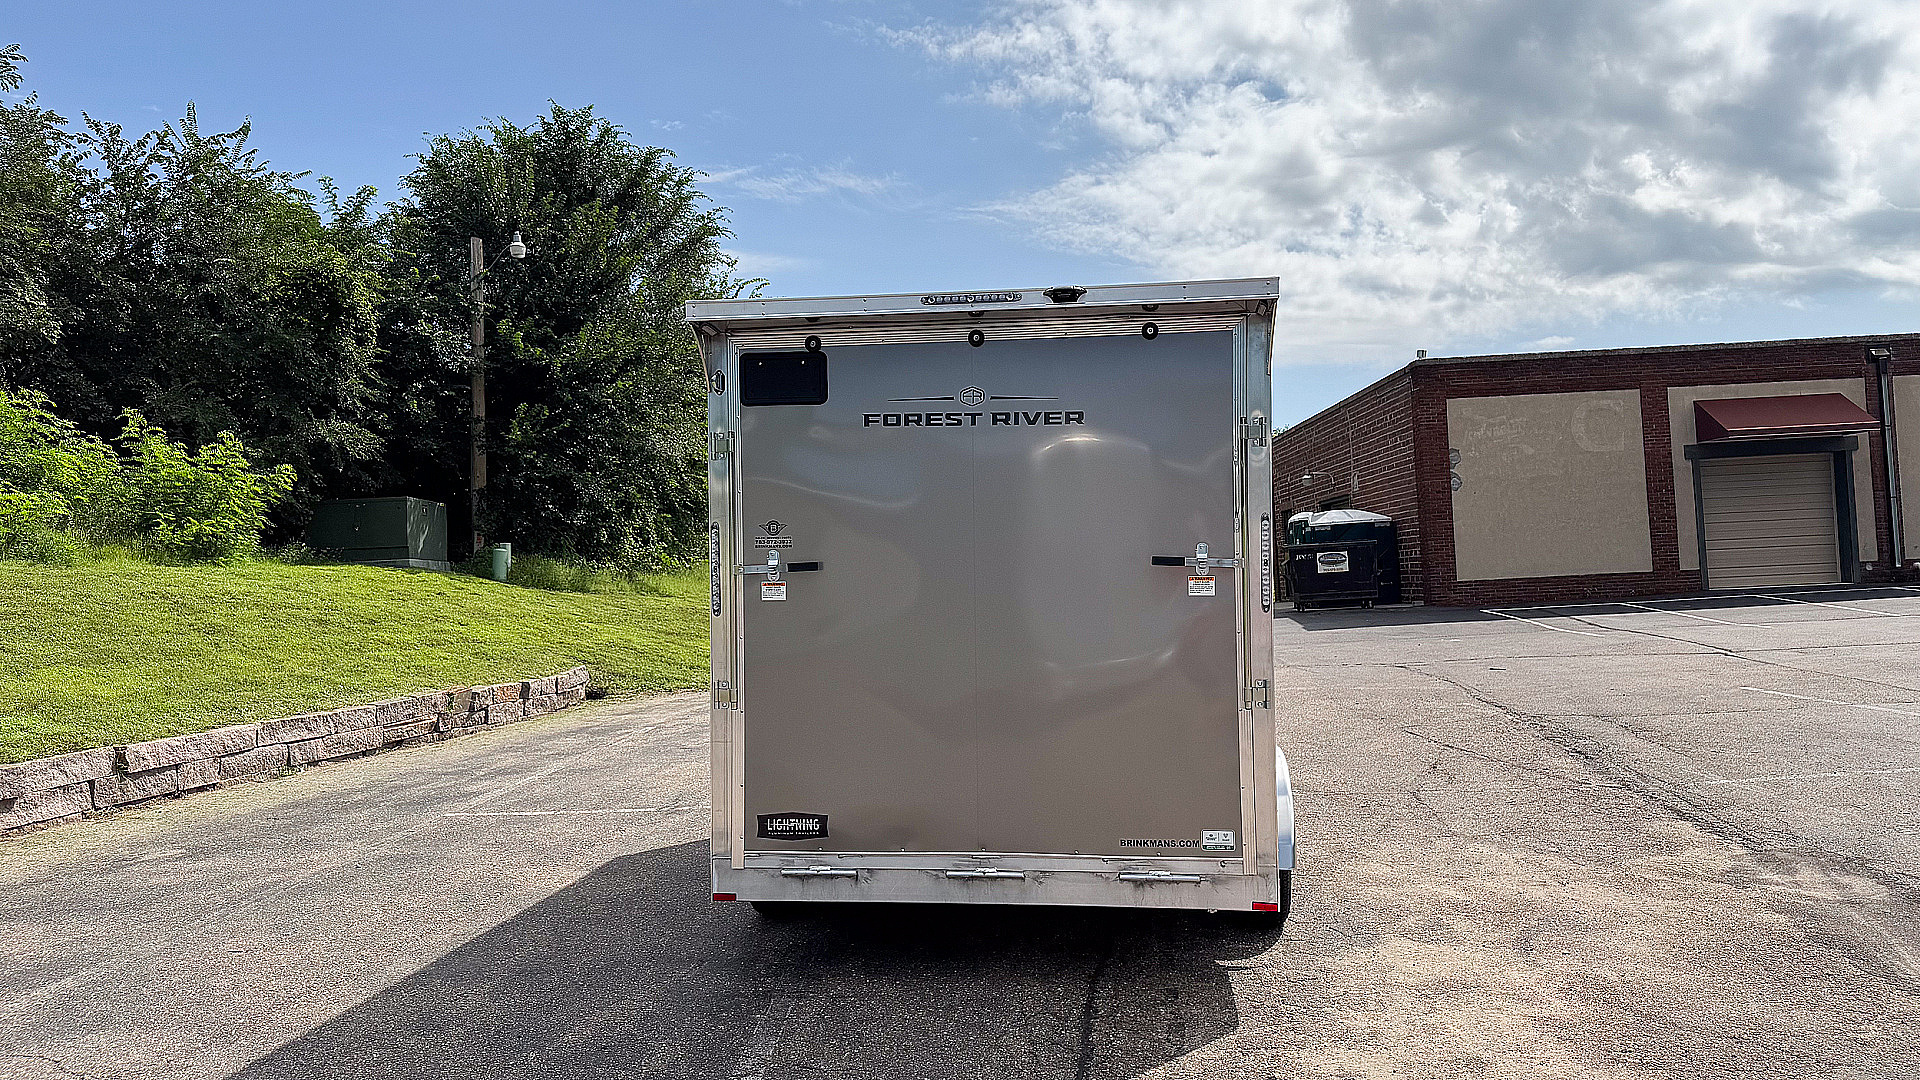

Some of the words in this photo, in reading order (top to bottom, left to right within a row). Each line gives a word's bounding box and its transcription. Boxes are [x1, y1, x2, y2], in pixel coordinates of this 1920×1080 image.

[862, 412, 983, 427] FOREST
[990, 410, 1085, 426] RIVER
[767, 818, 820, 831] LIGHTNING
[1120, 839, 1200, 848] BRINKMANS.COM
